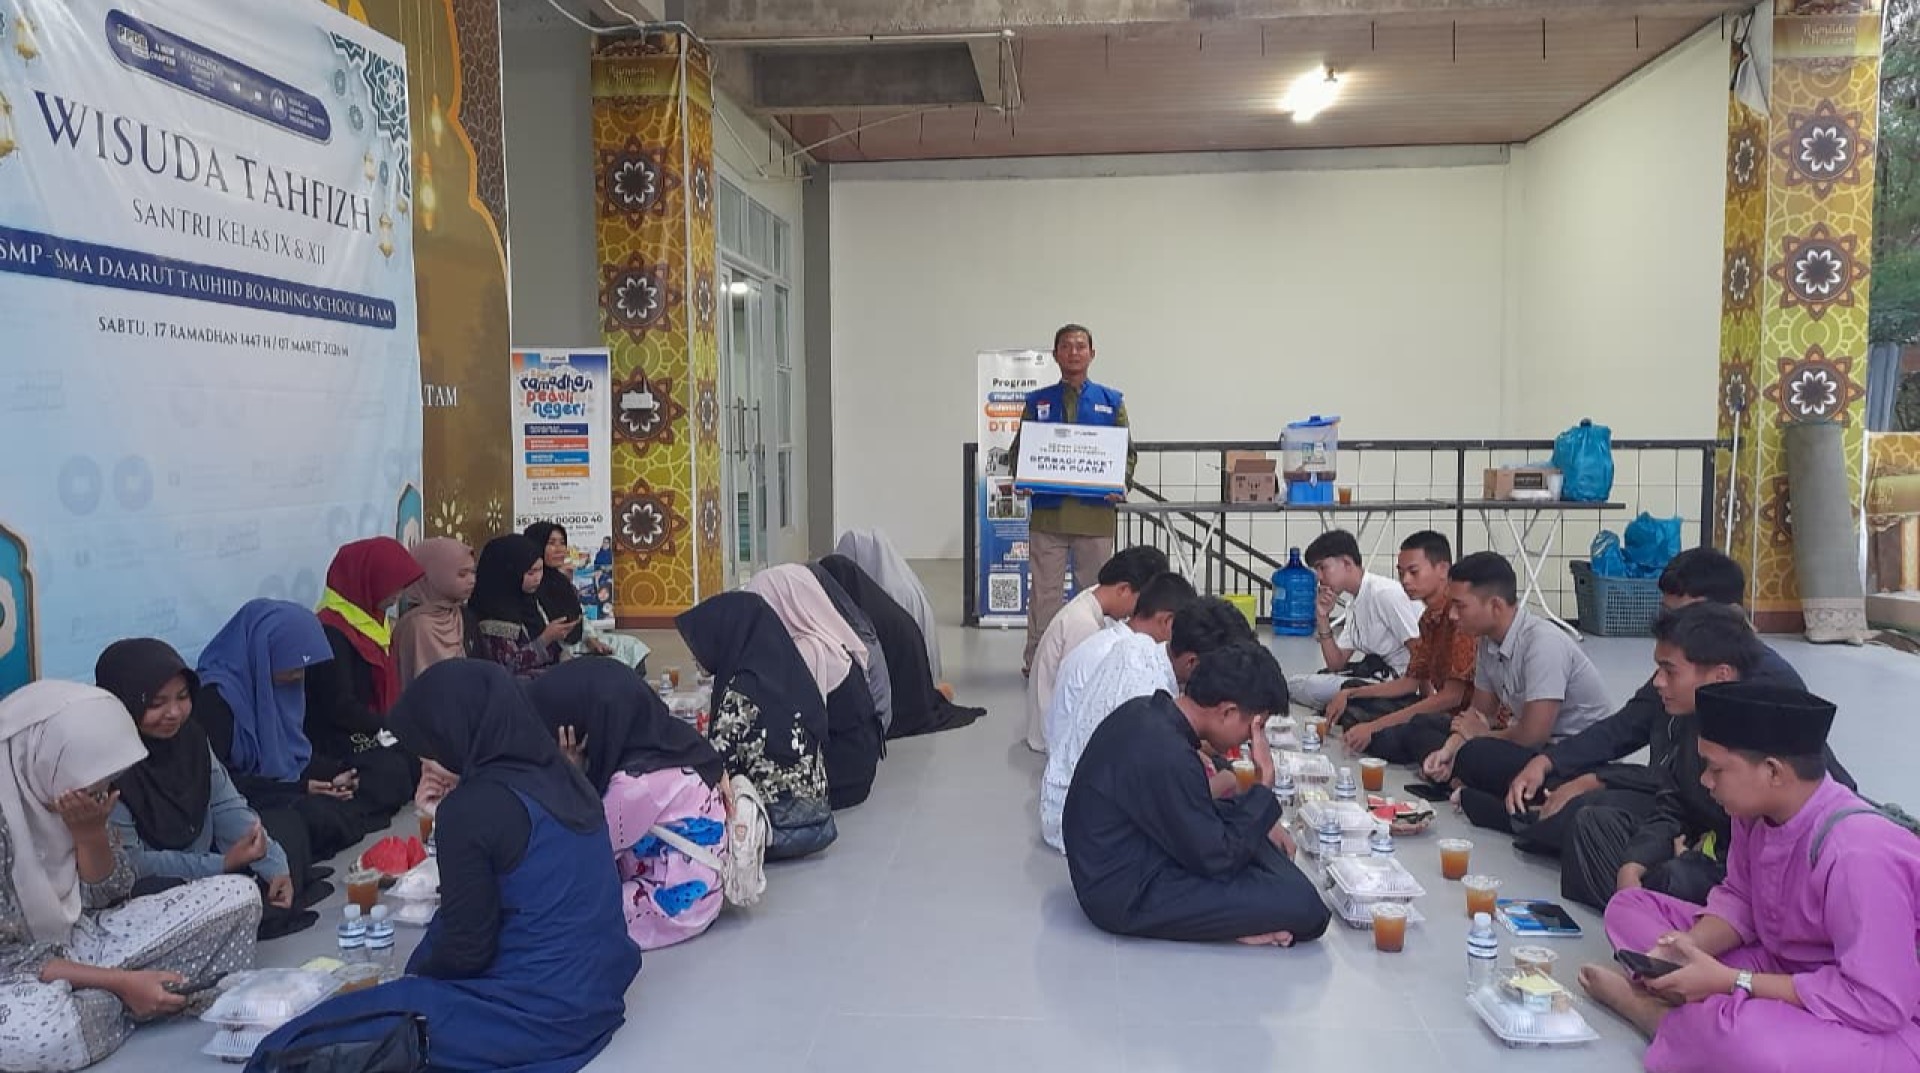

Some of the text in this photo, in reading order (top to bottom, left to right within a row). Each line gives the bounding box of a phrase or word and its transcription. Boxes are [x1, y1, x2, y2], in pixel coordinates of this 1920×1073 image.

[34, 90, 373, 234] WISUDA TAHFIZH
[133, 198, 325, 265] SANTRI KELAS IX & XII
[99, 256, 174, 286] DAARUT
[177, 269, 242, 297] TAUHIID
[245, 281, 312, 309] BOARDING
[312, 295, 356, 317] SCHOOL
[359, 303, 393, 322] BATAM
[98, 316, 149, 338] SABTU,
[155, 322, 166, 337] 17
[170, 324, 238, 345] RAMADHAN
[240, 332, 261, 347] 1447
[263, 335, 271, 349] H
[291, 340, 321, 355] MARET
[520, 373, 593, 392] ramadhan
[992, 377, 1038, 388] Program
[421, 384, 457, 407] TAM
[526, 387, 574, 407] peduli
[533, 402, 586, 419] negeri
[989, 421, 1008, 432] DT
[1030, 455, 1113, 469] BERBAGI PAKET
[1037, 463, 1105, 474] BUKA PUASA
